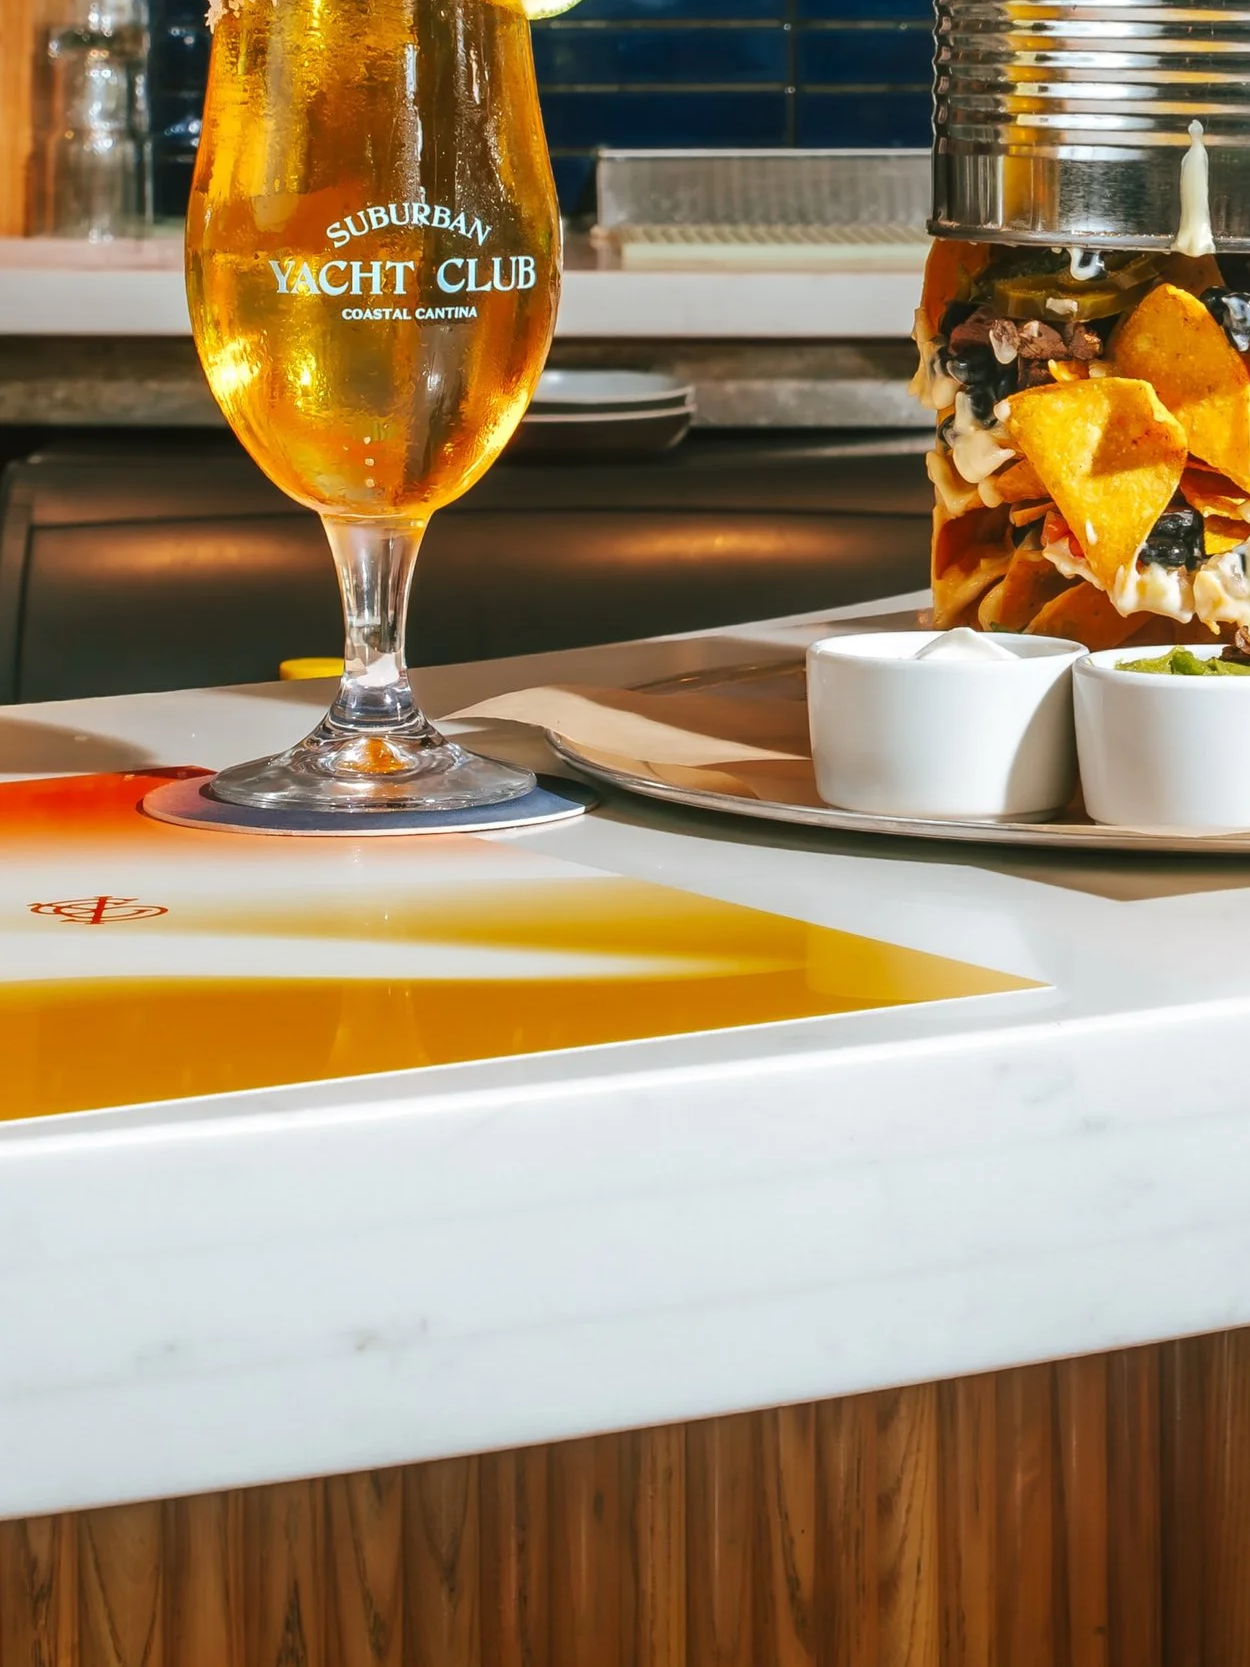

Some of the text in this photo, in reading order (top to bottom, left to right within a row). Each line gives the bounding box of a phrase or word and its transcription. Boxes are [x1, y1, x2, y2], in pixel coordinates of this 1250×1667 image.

[326, 202, 491, 248] SUBURBAN
[268, 256, 536, 295] YACHT CLUB
[341, 307, 477, 320] COASTAL CANTINA
